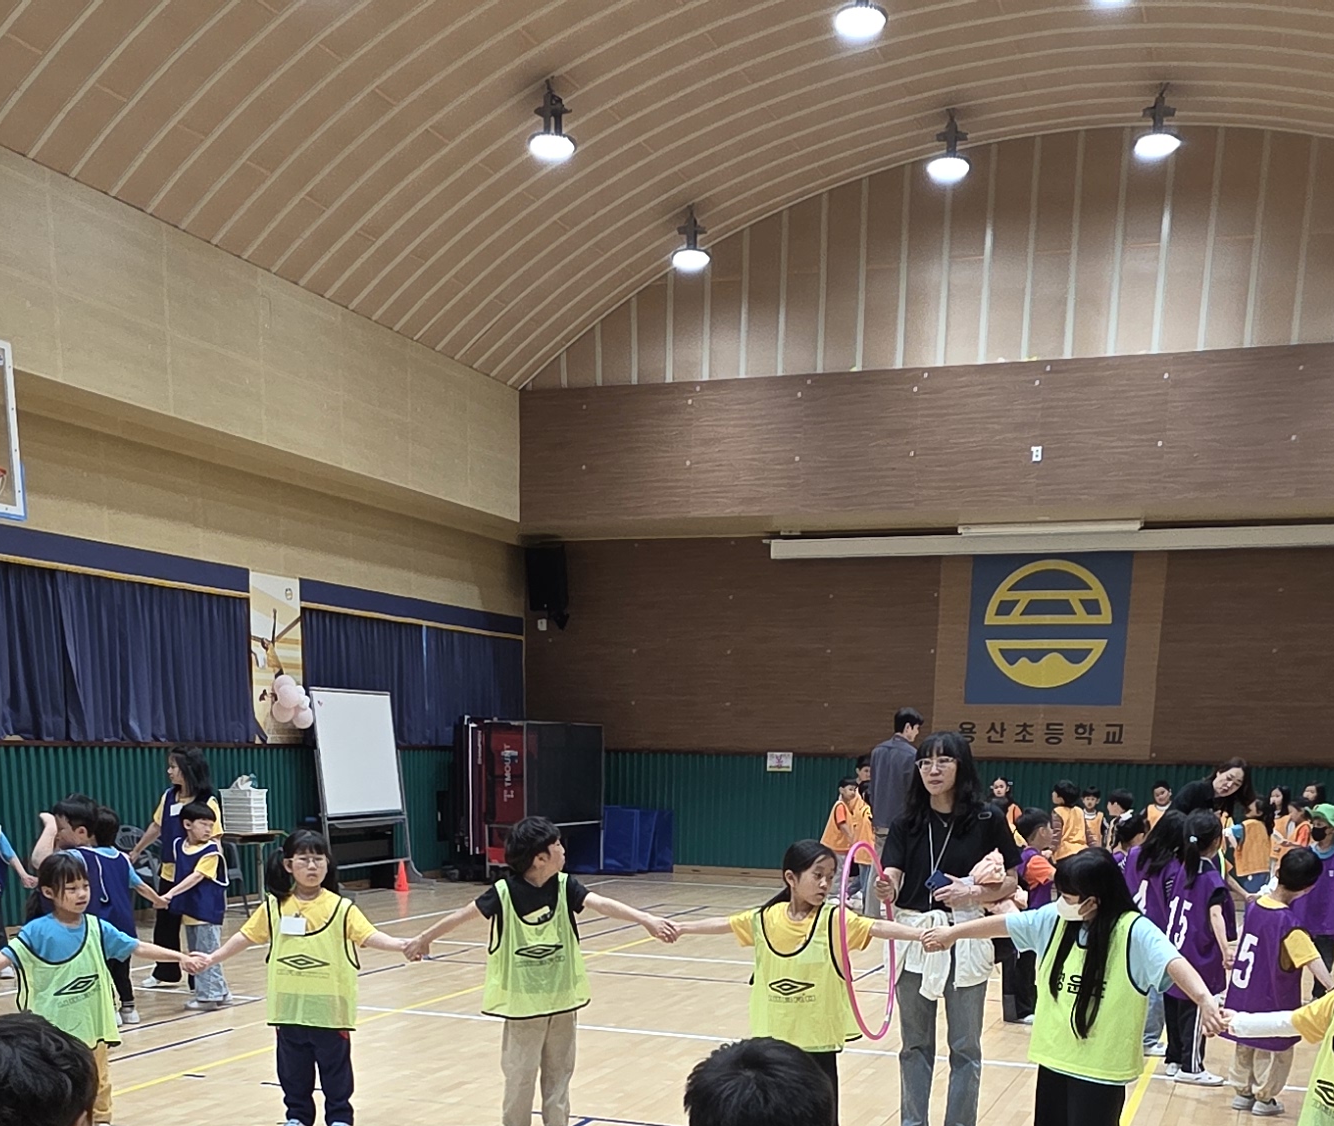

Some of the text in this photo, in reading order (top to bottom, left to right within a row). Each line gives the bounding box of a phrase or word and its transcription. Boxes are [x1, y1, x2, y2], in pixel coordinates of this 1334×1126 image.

[958, 721, 1124, 746] 용산초등학교
[1166, 896, 1193, 950] 15
[1232, 933, 1259, 989] 5
